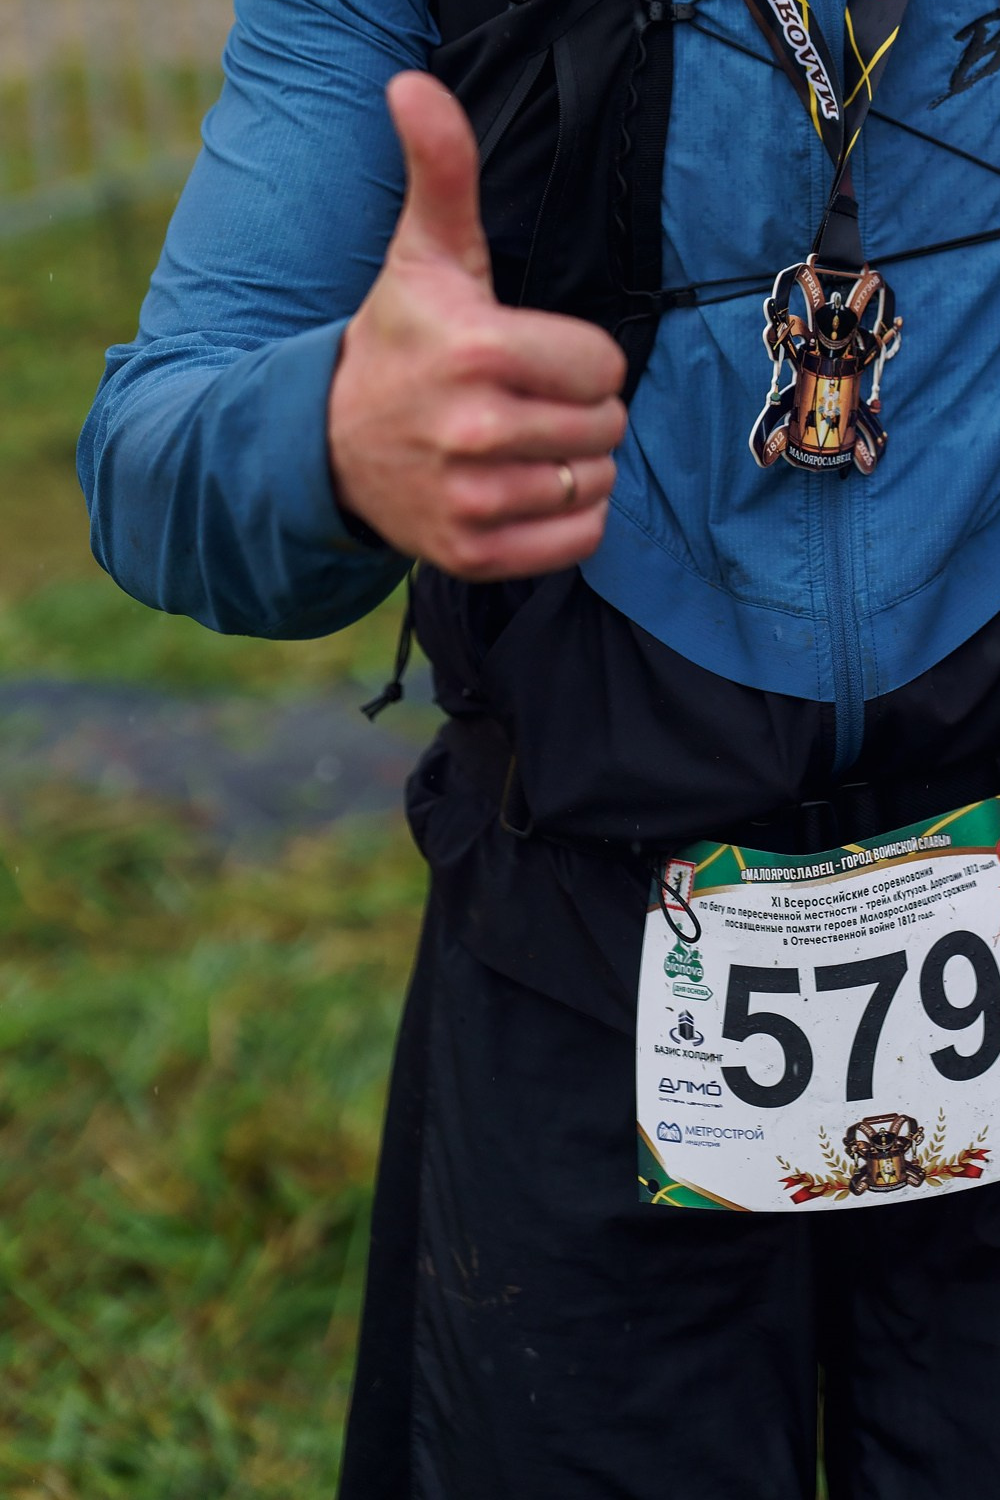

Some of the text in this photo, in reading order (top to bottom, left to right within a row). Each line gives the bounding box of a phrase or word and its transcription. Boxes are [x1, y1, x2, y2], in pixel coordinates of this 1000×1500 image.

[801, 268, 820, 308] ТРЕЙЛ
[853, 276, 880, 311] КУТУЗОВ
[766, 431, 785, 456] 1812
[789, 446, 852, 466] МАЛОЯРОСЛАВЕЦ
[841, 852, 873, 870] ГОРОД
[873, 837, 918, 861] ВОИНСКОЙ
[699, 901, 708, 910] по
[709, 901, 726, 915] бегу
[727, 906, 737, 915] по
[738, 907, 802, 921] пересеченной
[804, 905, 858, 921] местности
[865, 896, 892, 911] трейл
[930, 871, 962, 891] Дорогами
[963, 863, 979, 877] 1812
[784, 887, 869, 910] Всероссийские
[872, 866, 934, 893] соревнования
[725, 880, 977, 934] посвященные памяти героев Малоярославецкого сражения
[783, 938, 788, 946] в
[791, 927, 867, 946] Отечественной
[869, 921, 896, 935] войне
[897, 913, 916, 927] 1812
[654, 1045, 724, 1062] БАЗИС ХОЛДИНГ
[685, 1124, 765, 1140] МЕТРОСТРОЙ
